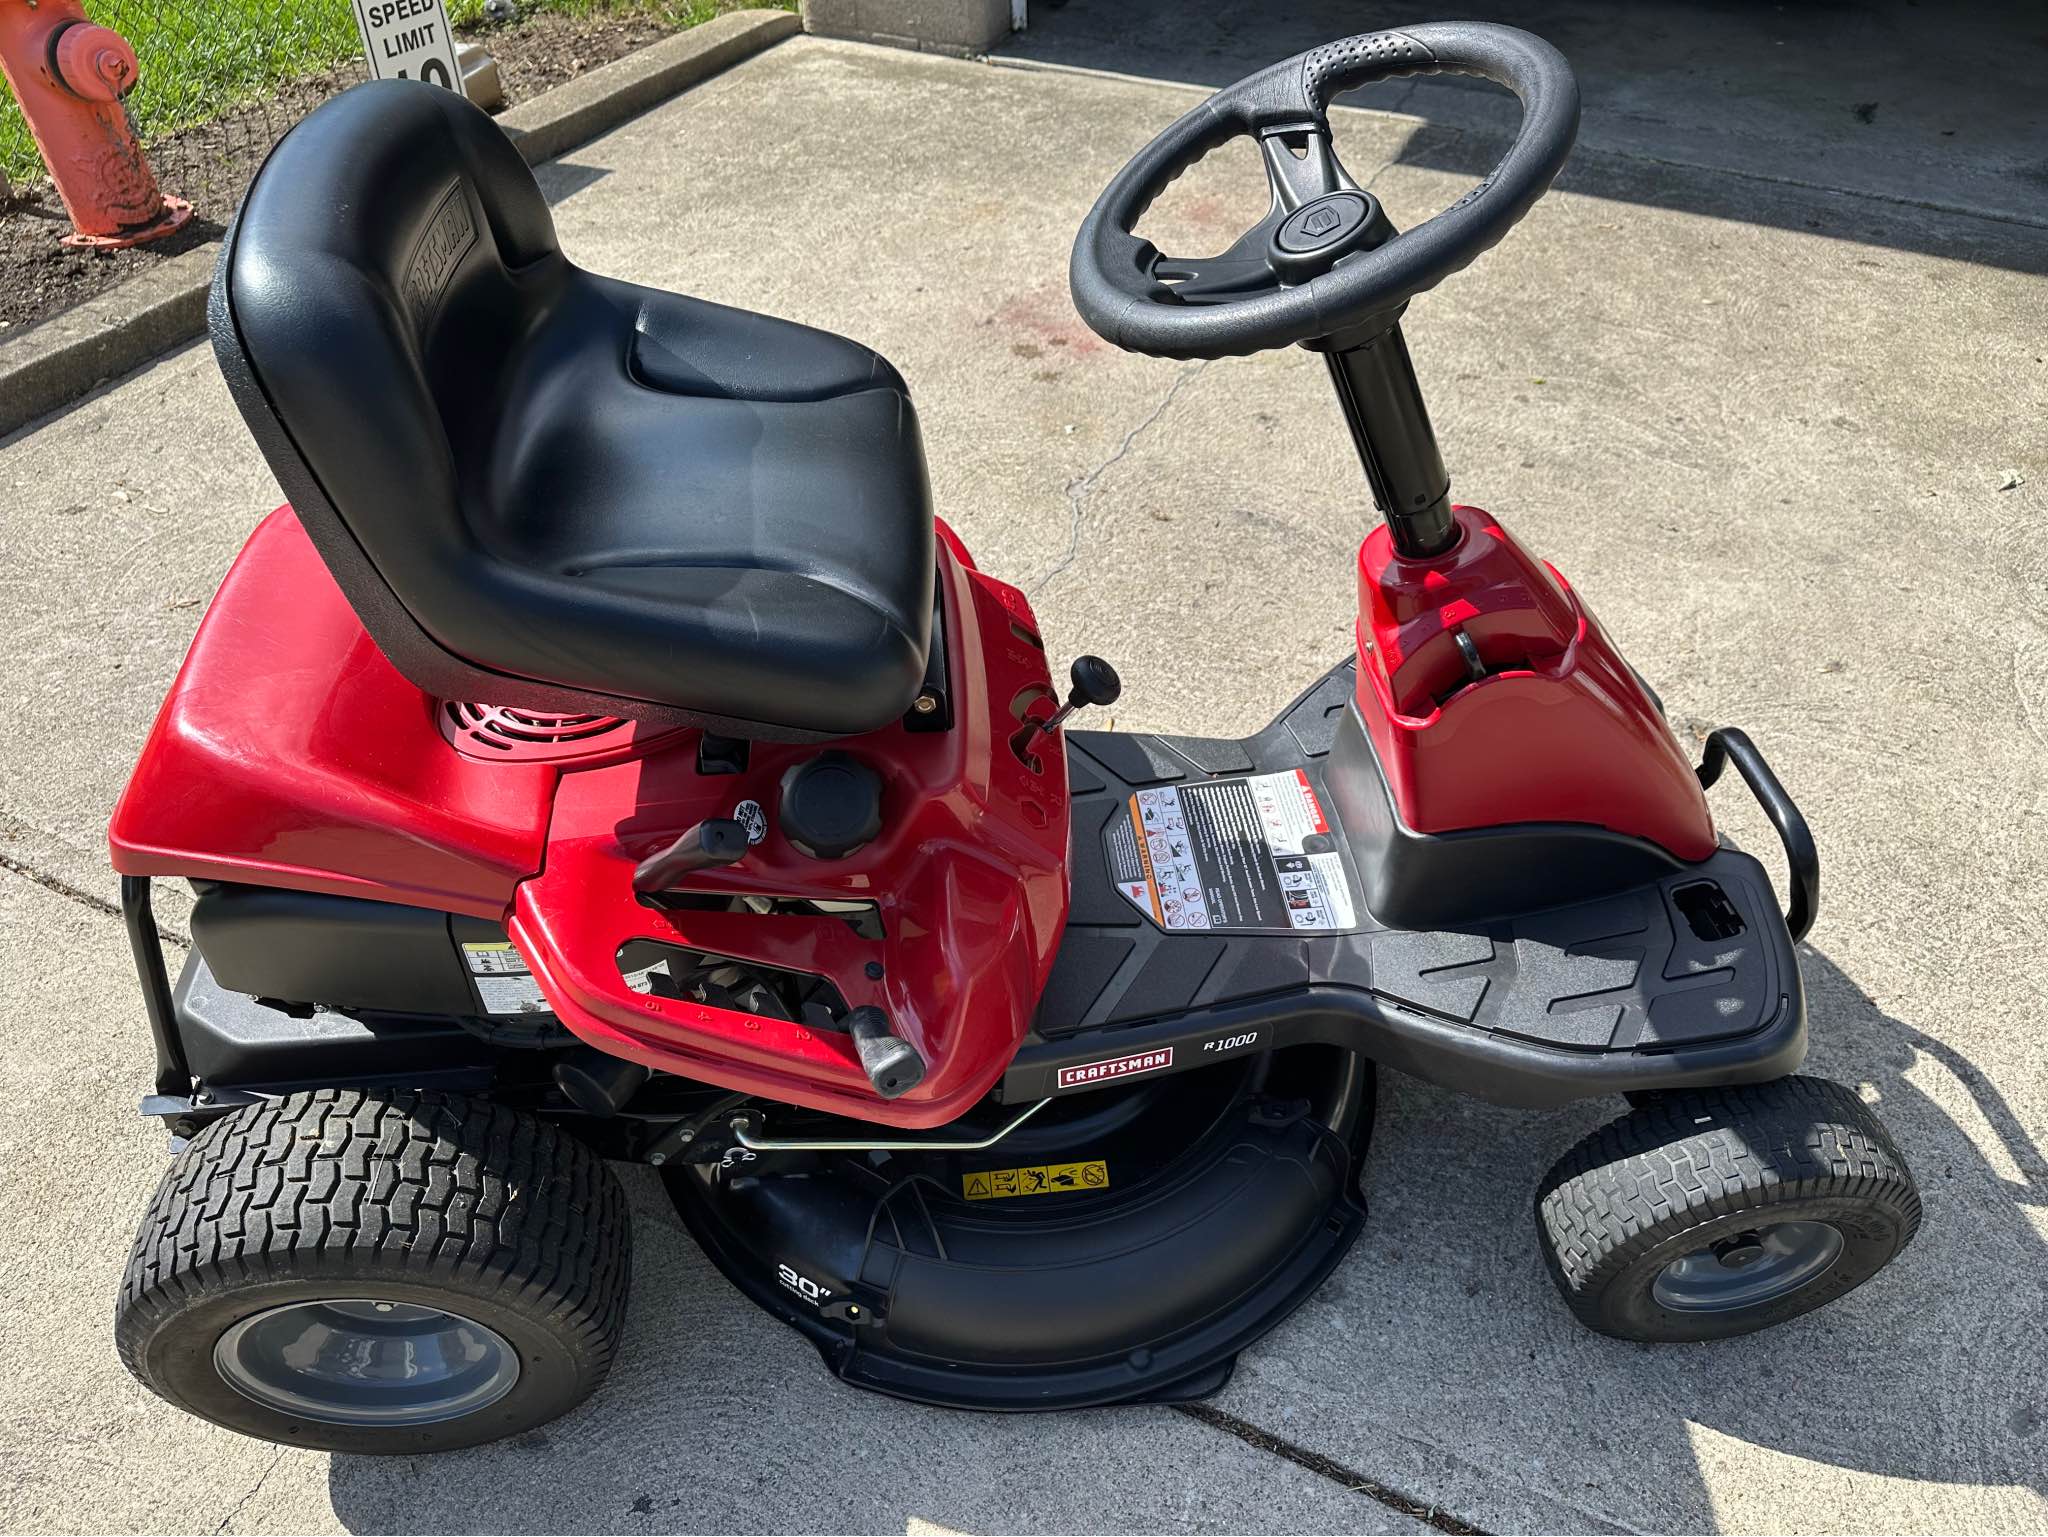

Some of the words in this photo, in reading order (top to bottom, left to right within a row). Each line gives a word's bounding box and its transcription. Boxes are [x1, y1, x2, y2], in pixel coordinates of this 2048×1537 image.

[368, 0, 434, 28] SPEED
[383, 22, 435, 58] LIMIT
[1140, 843, 1152, 879] WARNING
[1066, 1053, 1166, 1082] CRAFTSMAN
[1204, 1032, 1257, 1051] R1000
[779, 1263, 831, 1298] 30"
